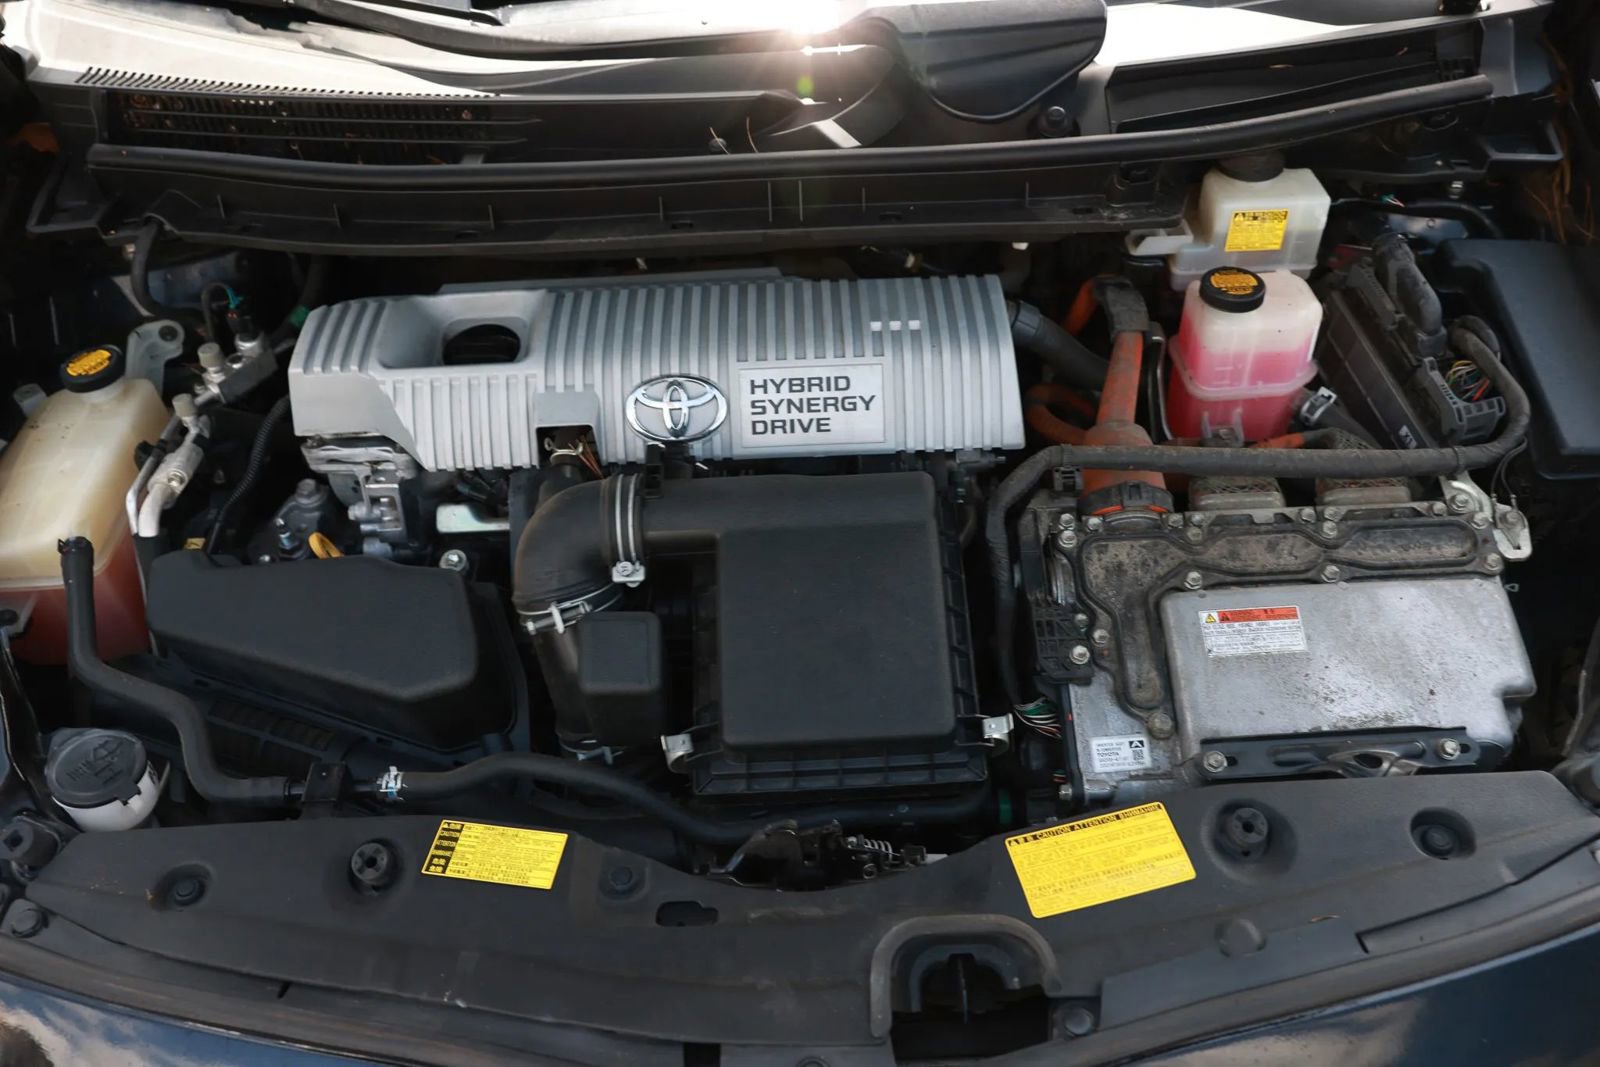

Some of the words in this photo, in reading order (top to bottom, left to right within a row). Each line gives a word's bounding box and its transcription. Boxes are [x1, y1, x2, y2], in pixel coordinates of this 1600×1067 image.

[750, 376, 850, 395] HYBRID
[751, 395, 876, 415] SYNERGY
[752, 417, 831, 435] DRIVE
[1037, 825, 1071, 839] CAUTION
[1074, 814, 1117, 831] ATTENTION
